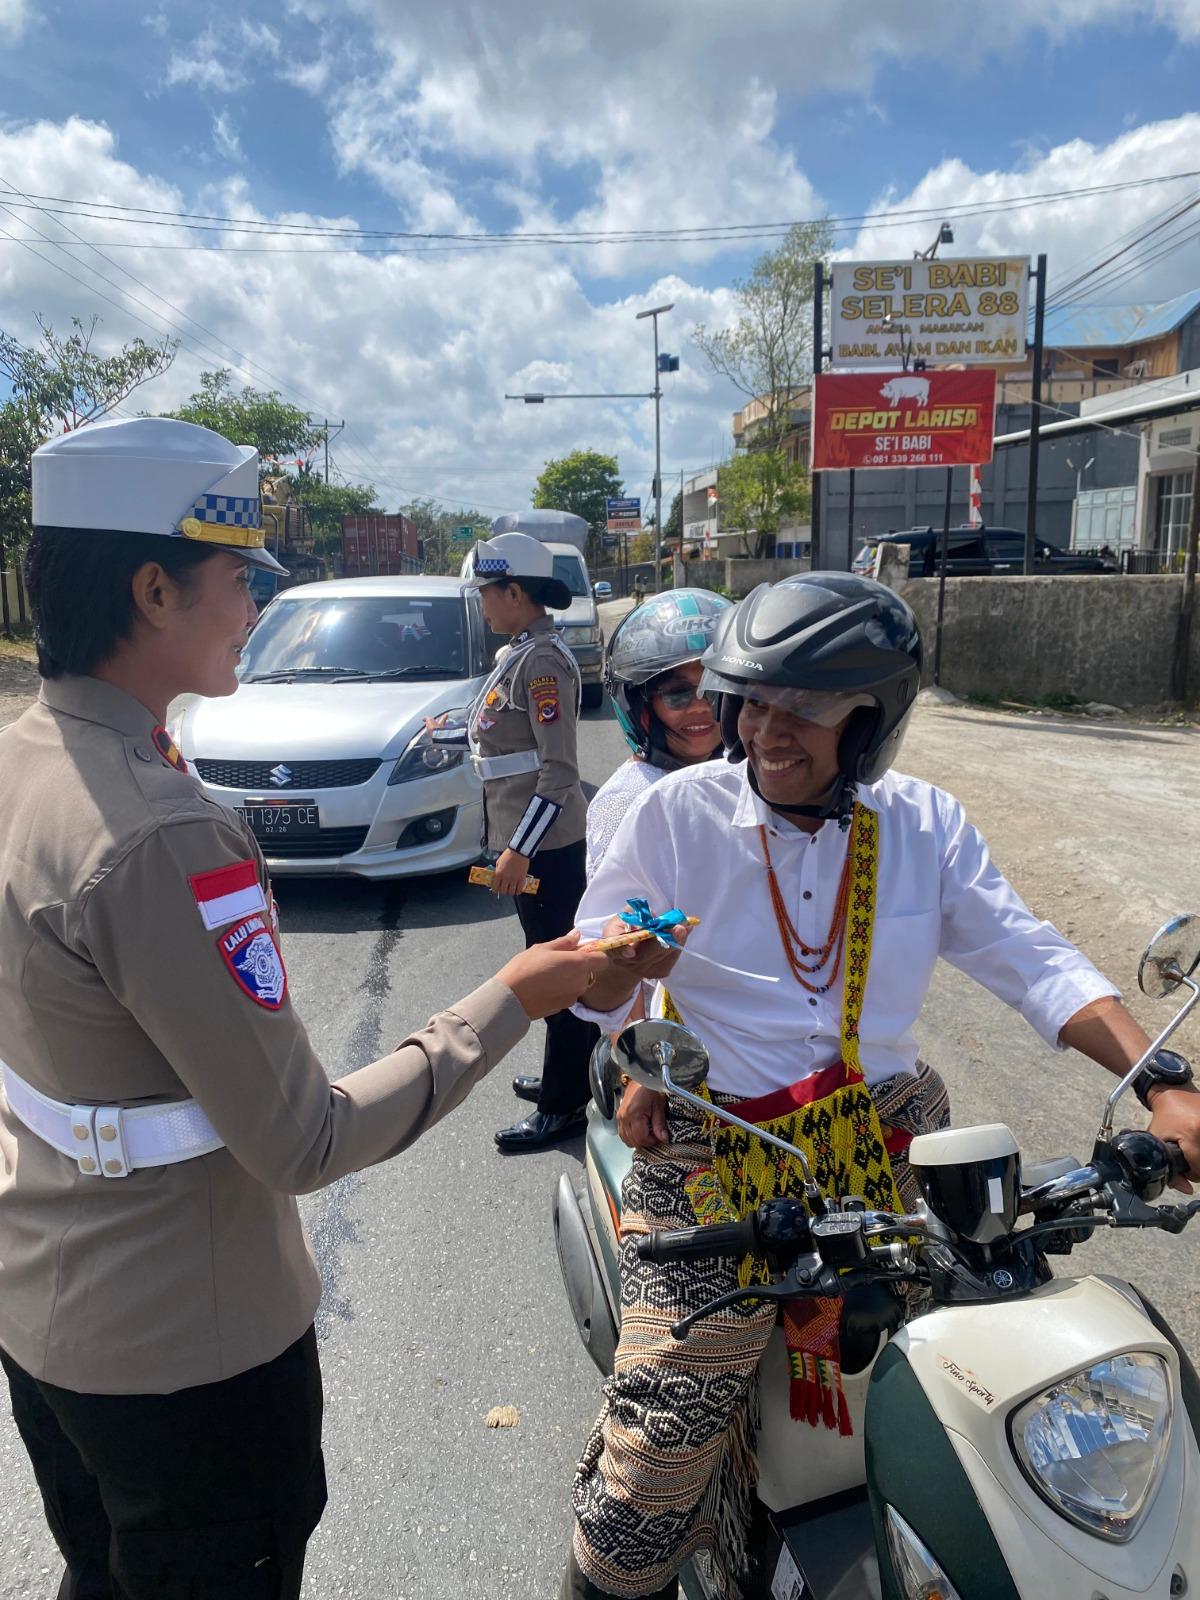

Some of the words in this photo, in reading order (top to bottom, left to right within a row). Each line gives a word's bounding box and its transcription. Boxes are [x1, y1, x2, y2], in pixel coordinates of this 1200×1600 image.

[928, 262, 1007, 289] BABI
[840, 292, 971, 320] SELERA
[977, 291, 1019, 316] 88
[936, 341, 972, 355] DAN
[975, 338, 1017, 354] IKAN
[830, 410, 901, 431] DEPOT
[904, 408, 978, 428] LARISA
[902, 435, 931, 450] BABI
[873, 455, 888, 464] 081
[929, 453, 943, 462] 111
[721, 655, 764, 671] HONDA
[260, 807, 291, 825] 1375
[297, 807, 316, 824] CE
[223, 925, 248, 952] LALU
[943, 1360, 964, 1381] Fino
[965, 1379, 996, 1406] Sporty
